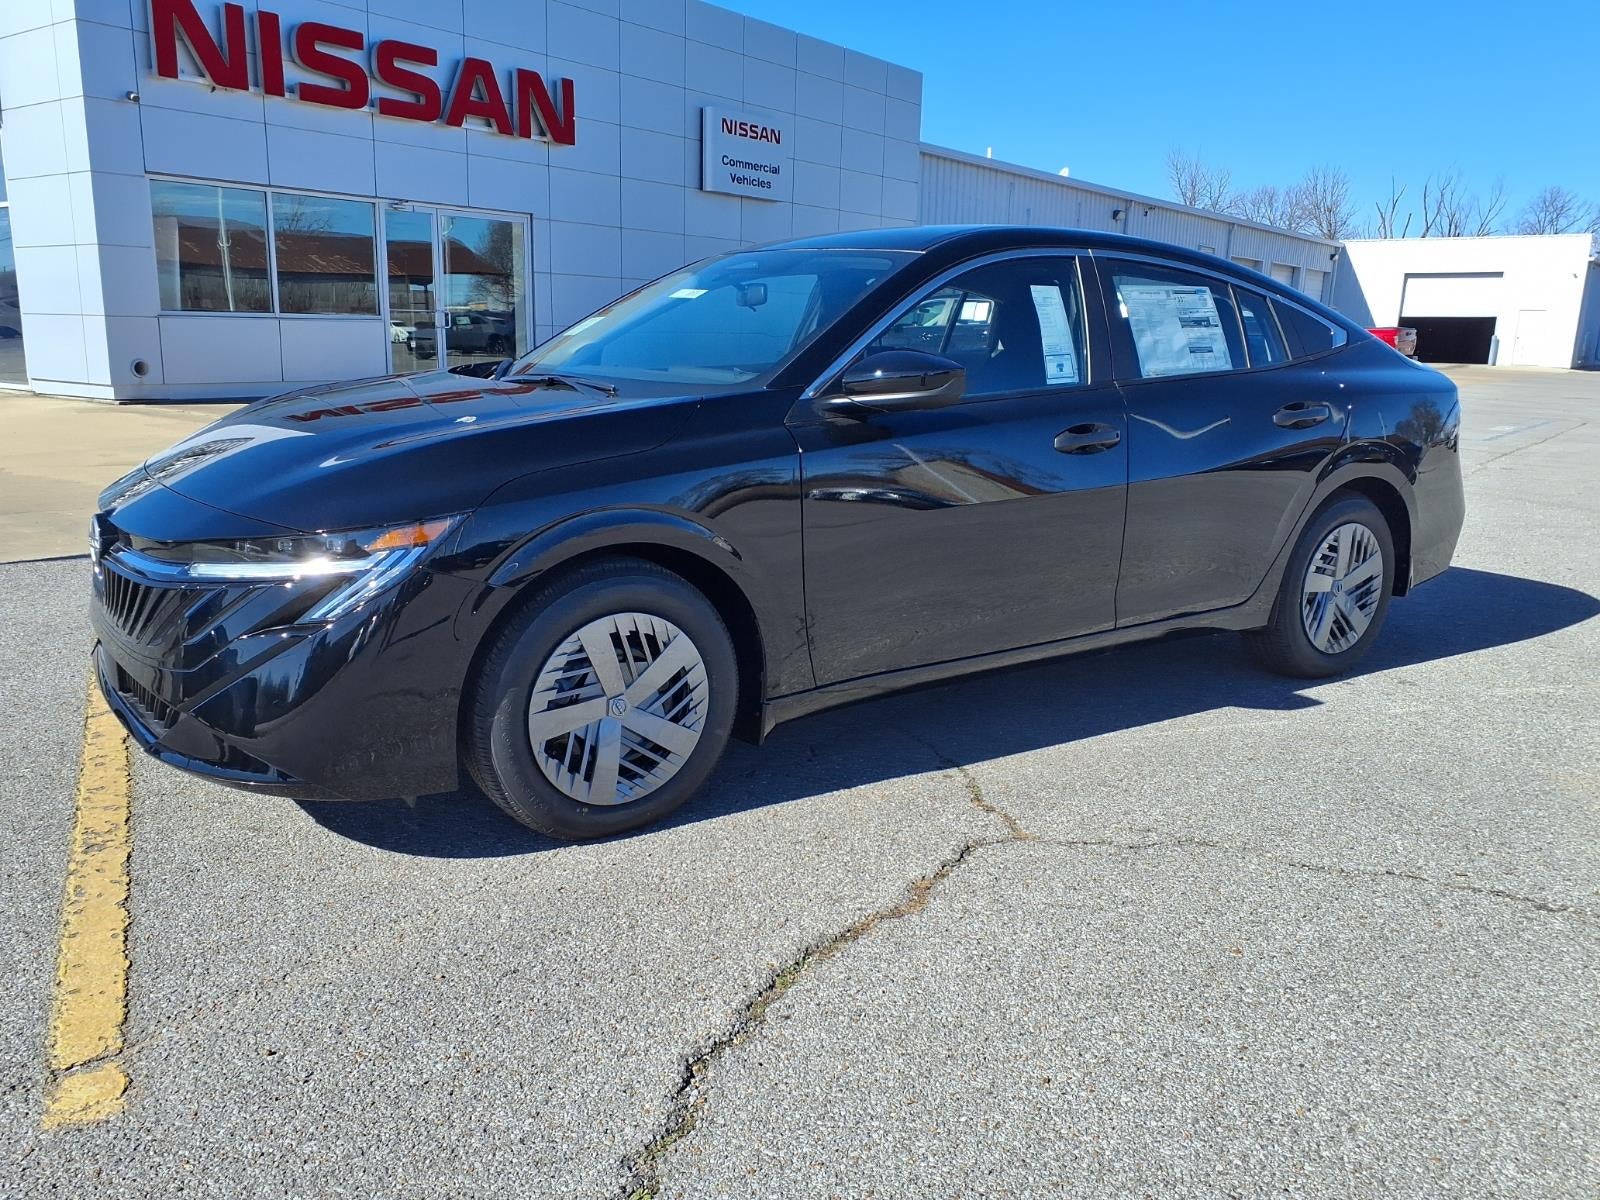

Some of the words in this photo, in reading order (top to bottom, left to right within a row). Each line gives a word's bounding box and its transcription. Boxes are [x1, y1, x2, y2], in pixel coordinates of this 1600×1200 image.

[149, 0, 575, 145] NISSAN
[721, 117, 781, 145] NISSAN
[721, 154, 780, 175] Commercial
[730, 172, 772, 189] Vehicles
